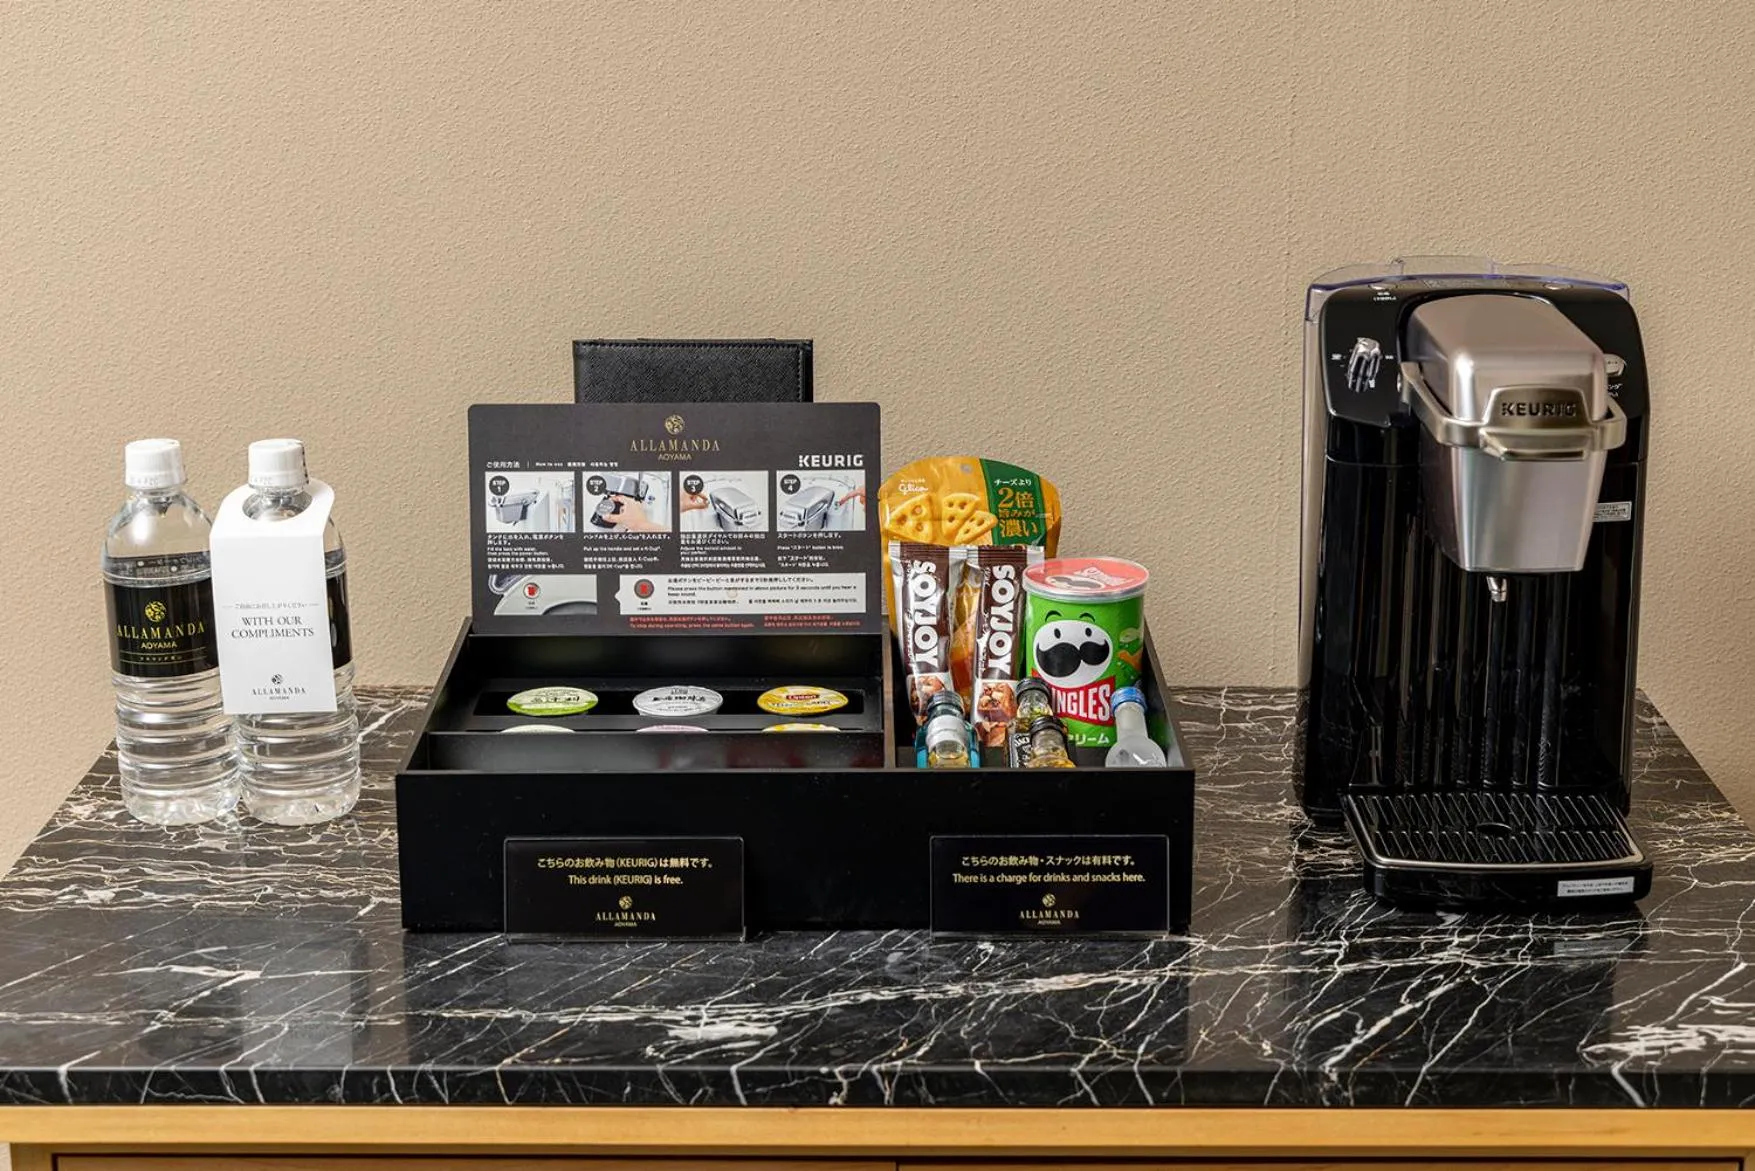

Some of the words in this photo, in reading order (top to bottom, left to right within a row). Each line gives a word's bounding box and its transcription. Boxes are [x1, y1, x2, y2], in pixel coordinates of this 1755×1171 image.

[1502, 402, 1576, 416] KEURIG
[630, 439, 720, 452] ALLAMANDA
[658, 453, 692, 461] AOYAMA
[798, 454, 864, 467] KEURIG
[993, 478, 1032, 487] チーズより
[898, 483, 929, 495] Glico
[997, 487, 1034, 508] 2倍
[1000, 519, 1038, 538] 濃い
[913, 560, 939, 669] SOYJOY
[242, 616, 274, 626] WITH
[277, 616, 303, 625] OUR
[988, 565, 1016, 678] SOYJOY
[117, 621, 205, 639] ALLAMANDA
[231, 627, 315, 638] COMPLIMENTS
[141, 641, 177, 649] AOYAMA
[252, 687, 306, 696] ALLAMANDA
[961, 855, 1135, 866] こちらのお飲み物・スナックは有料です。
[568, 875, 587, 885] This
[589, 875, 612, 885] drink
[613, 875, 652, 885] (KEURIG)
[654, 875, 661, 885] is
[663, 875, 683, 885] free.
[952, 873, 979, 883] There
[980, 873, 987, 883] is
[989, 875, 995, 883] a
[996, 873, 1027, 885] charge
[1028, 873, 1042, 883] for
[1043, 873, 1071, 883] drinks
[1072, 873, 1089, 883] and
[1090, 873, 1121, 883] snacks
[1122, 873, 1146, 883] here.
[595, 912, 656, 921] ALLAMANDA
[1019, 910, 1080, 919] ALLAMANDA
